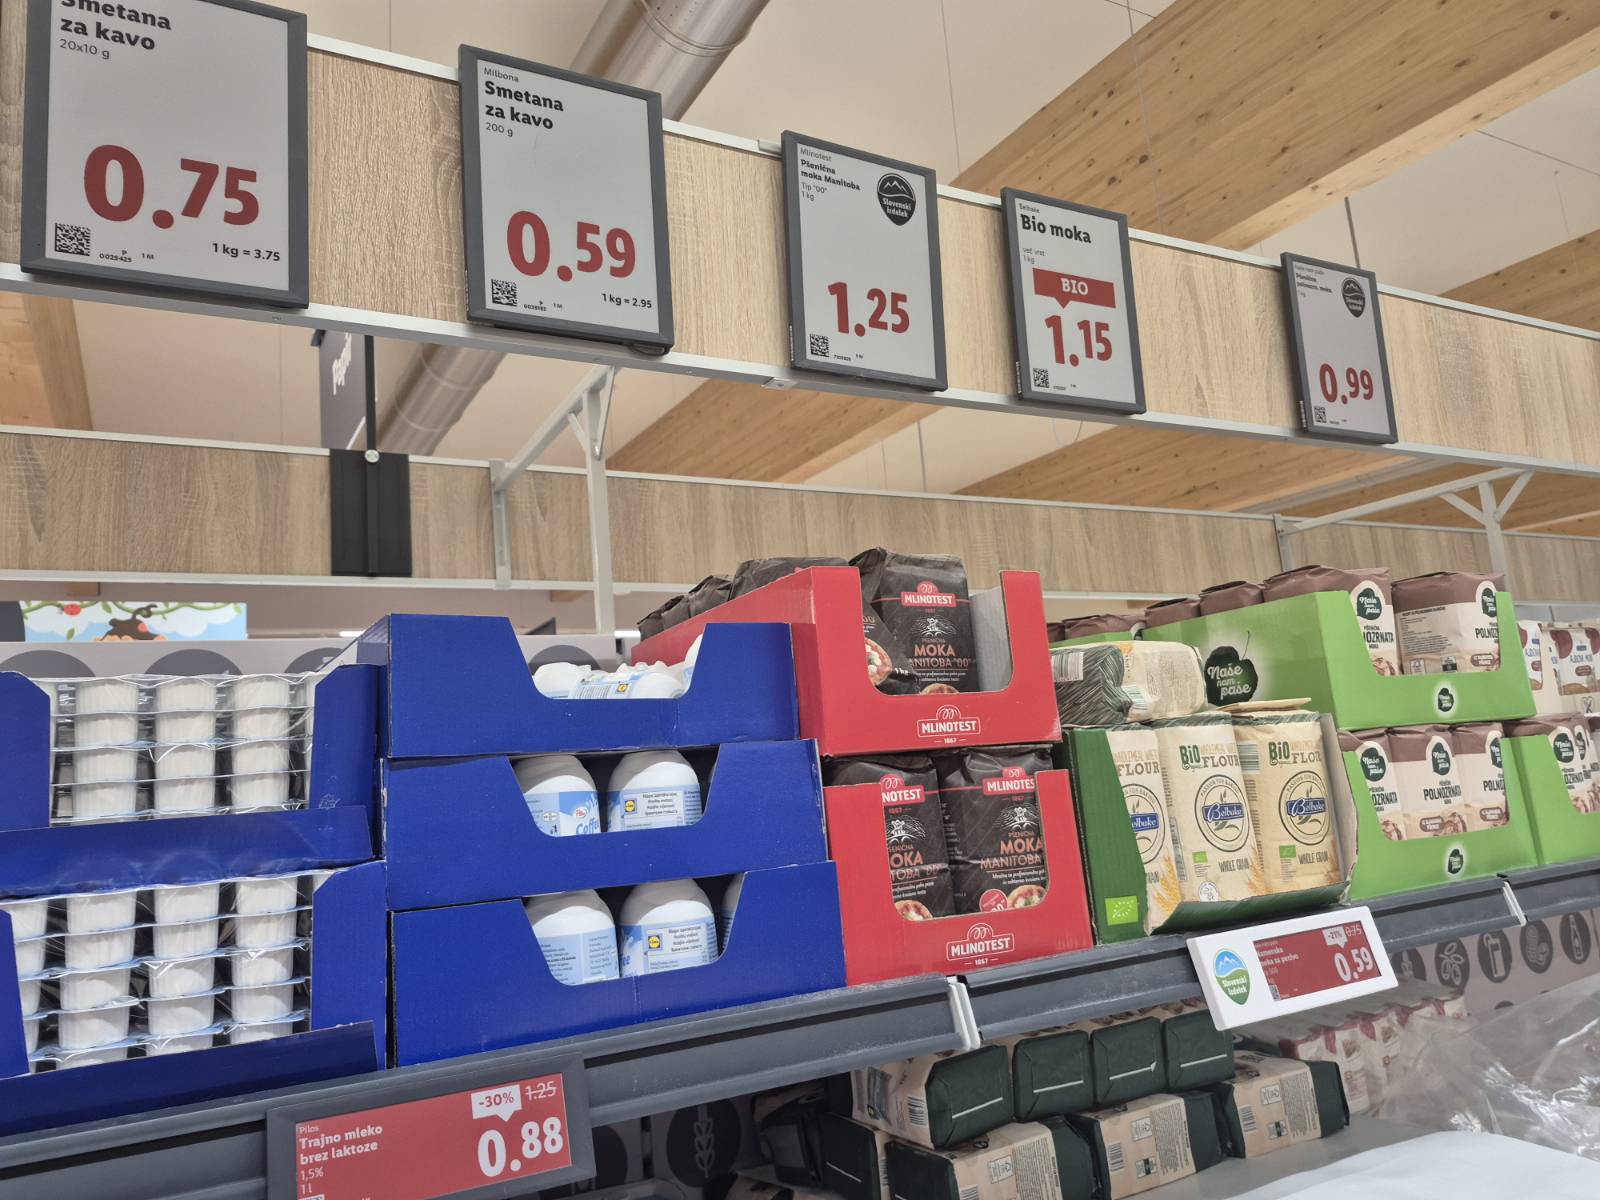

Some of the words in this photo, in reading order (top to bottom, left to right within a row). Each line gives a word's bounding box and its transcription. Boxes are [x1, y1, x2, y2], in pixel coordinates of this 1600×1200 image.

[60, 16, 88, 36] za
[95, 20, 155, 50] kavo
[59, 38, 98, 56] 20x10
[102, 48, 110, 60] g
[484, 67, 519, 83] Milbona
[484, 80, 564, 112] Smetana
[485, 104, 505, 120] za
[510, 107, 554, 130] kavo
[485, 122, 504, 135] 200
[507, 128, 513, 138] g
[84, 144, 259, 229] 0.75
[801, 170, 822, 181] moka
[824, 175, 861, 191] Manitoba
[1020, 213, 1047, 234] Bio
[1049, 225, 1092, 244] moka
[212, 243, 219, 253] 1
[222, 243, 239, 259] kg
[254, 248, 280, 262] 3.75
[506, 211, 636, 282] 0.59
[1060, 277, 1089, 296] BIO
[602, 293, 607, 303] 1
[609, 294, 622, 308] kg
[632, 297, 652, 309] 2.95
[827, 281, 910, 337] 1.25
[1044, 314, 1113, 368] 1.15
[1319, 363, 1374, 405] 0.99
[904, 594, 953, 605] MLINOTEST
[1363, 631, 1394, 643] OZRNATA
[913, 644, 956, 657] MOKA
[1207, 663, 1244, 680] Naše
[1220, 681, 1252, 701] paše
[921, 720, 978, 734] MLINOTEST
[1117, 761, 1160, 777] FLOUR
[1201, 754, 1240, 769] FLOUR
[881, 787, 922, 803] NOTEST
[1371, 791, 1398, 806] OZRNATA
[1207, 803, 1242, 824] Belbake
[1291, 798, 1325, 818] Belbake
[1131, 817, 1157, 829] elbake
[890, 850, 924, 868] OKA
[980, 853, 1042, 870] MANITOBA
[890, 868, 921, 882] TOBA
[951, 938, 1011, 957] MLINOTEST
[1333, 947, 1374, 983] 0.59
[478, 1091, 515, 1108] -30%
[525, 1081, 556, 1101] 1.25
[299, 1124, 320, 1134] Pilos
[299, 1133, 341, 1150] Trajno
[344, 1124, 384, 1140] mleko
[300, 1151, 329, 1165] brez
[331, 1140, 378, 1160] laktoze
[477, 1116, 564, 1178] 0.88
[300, 1166, 324, 1181] 1,5%
